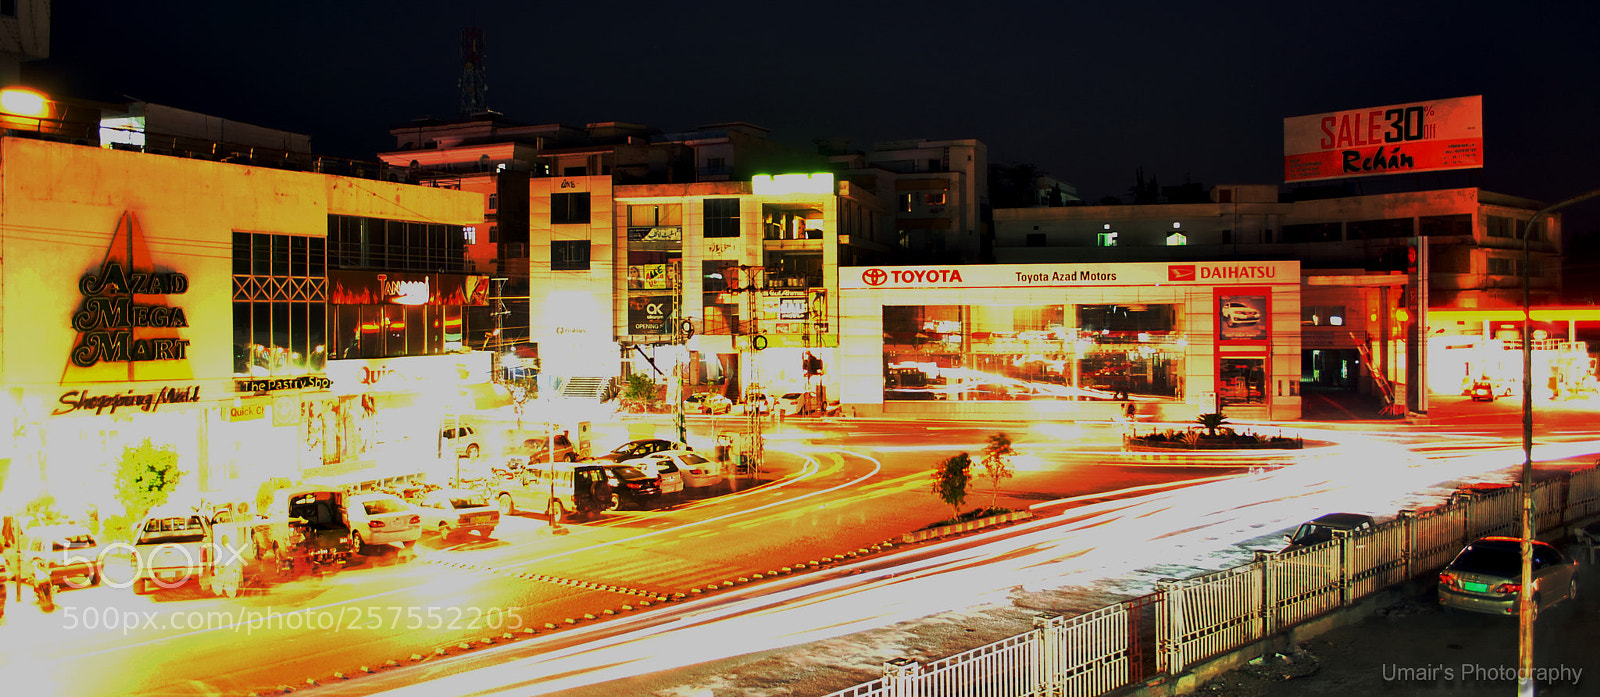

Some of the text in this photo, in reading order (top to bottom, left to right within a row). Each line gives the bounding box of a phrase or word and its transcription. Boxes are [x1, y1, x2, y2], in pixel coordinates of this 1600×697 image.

[1321, 111, 1383, 149] SALE
[1384, 106, 1424, 143] 30
[79, 262, 189, 296] AZAD
[891, 269, 963, 283] TOYOTA
[1015, 270, 1117, 284] Toyota Azad Motors
[1200, 266, 1276, 279] DAIHATSU
[71, 296, 190, 332] MEGA
[71, 331, 191, 367] MART
[244, 382, 265, 391] The
[268, 380, 306, 388] Pastry
[51, 389, 153, 415] Shopping
[230, 407, 253, 418] Quick
